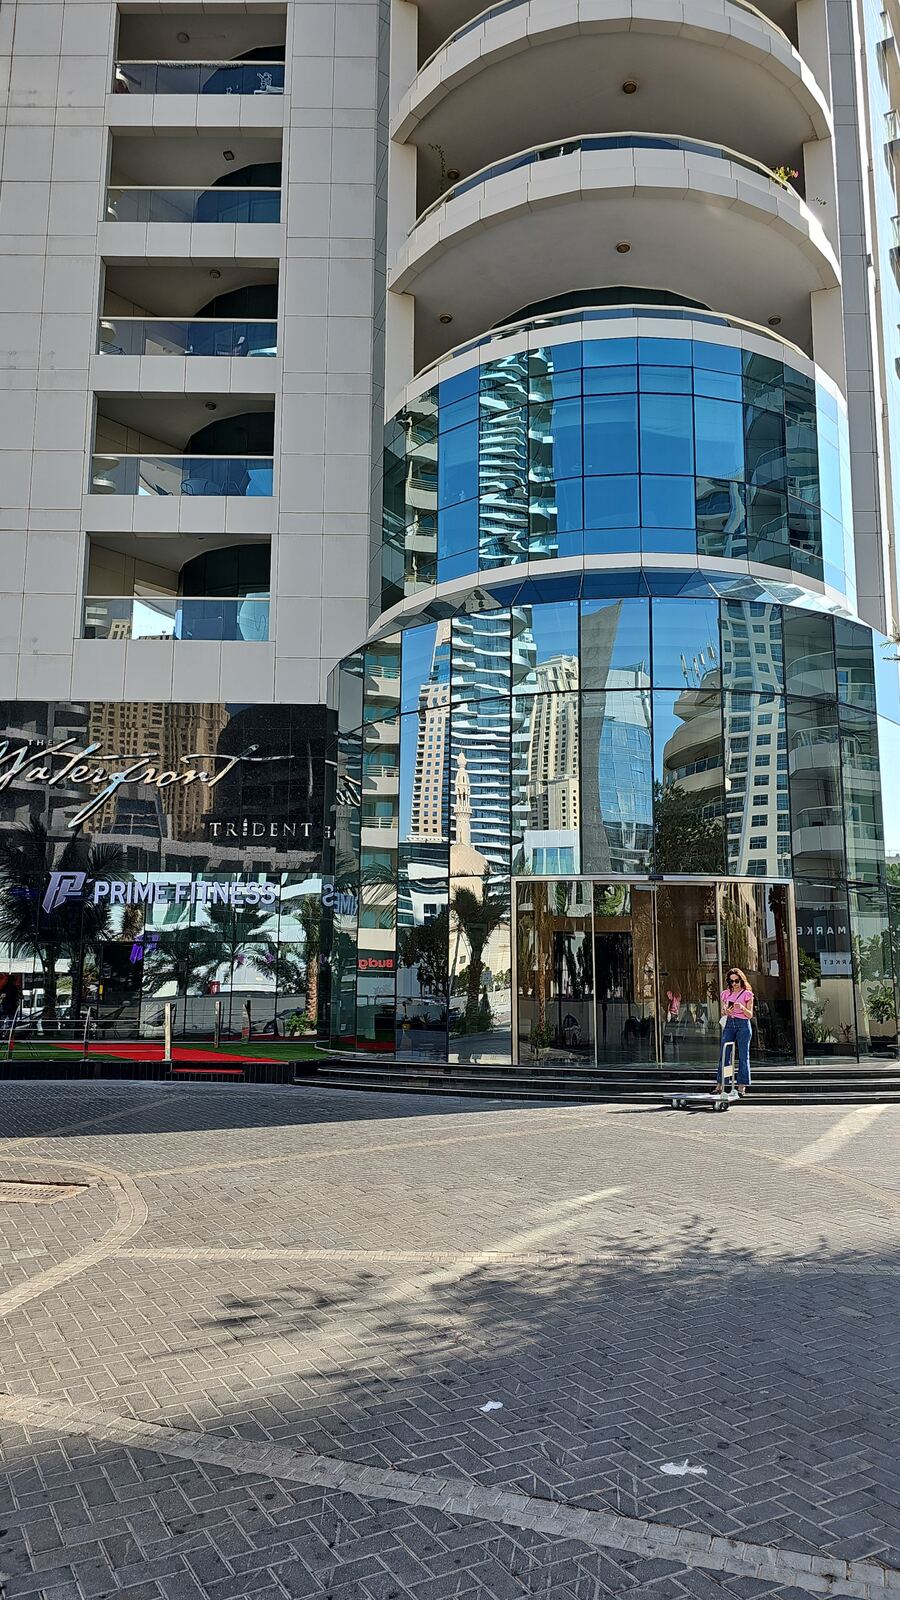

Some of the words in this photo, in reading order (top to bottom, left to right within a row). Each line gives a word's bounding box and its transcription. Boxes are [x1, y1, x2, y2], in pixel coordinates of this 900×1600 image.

[209, 818, 313, 837] TRIDENT
[94, 881, 170, 905] PRIME
[175, 881, 277, 905] FITNESS
